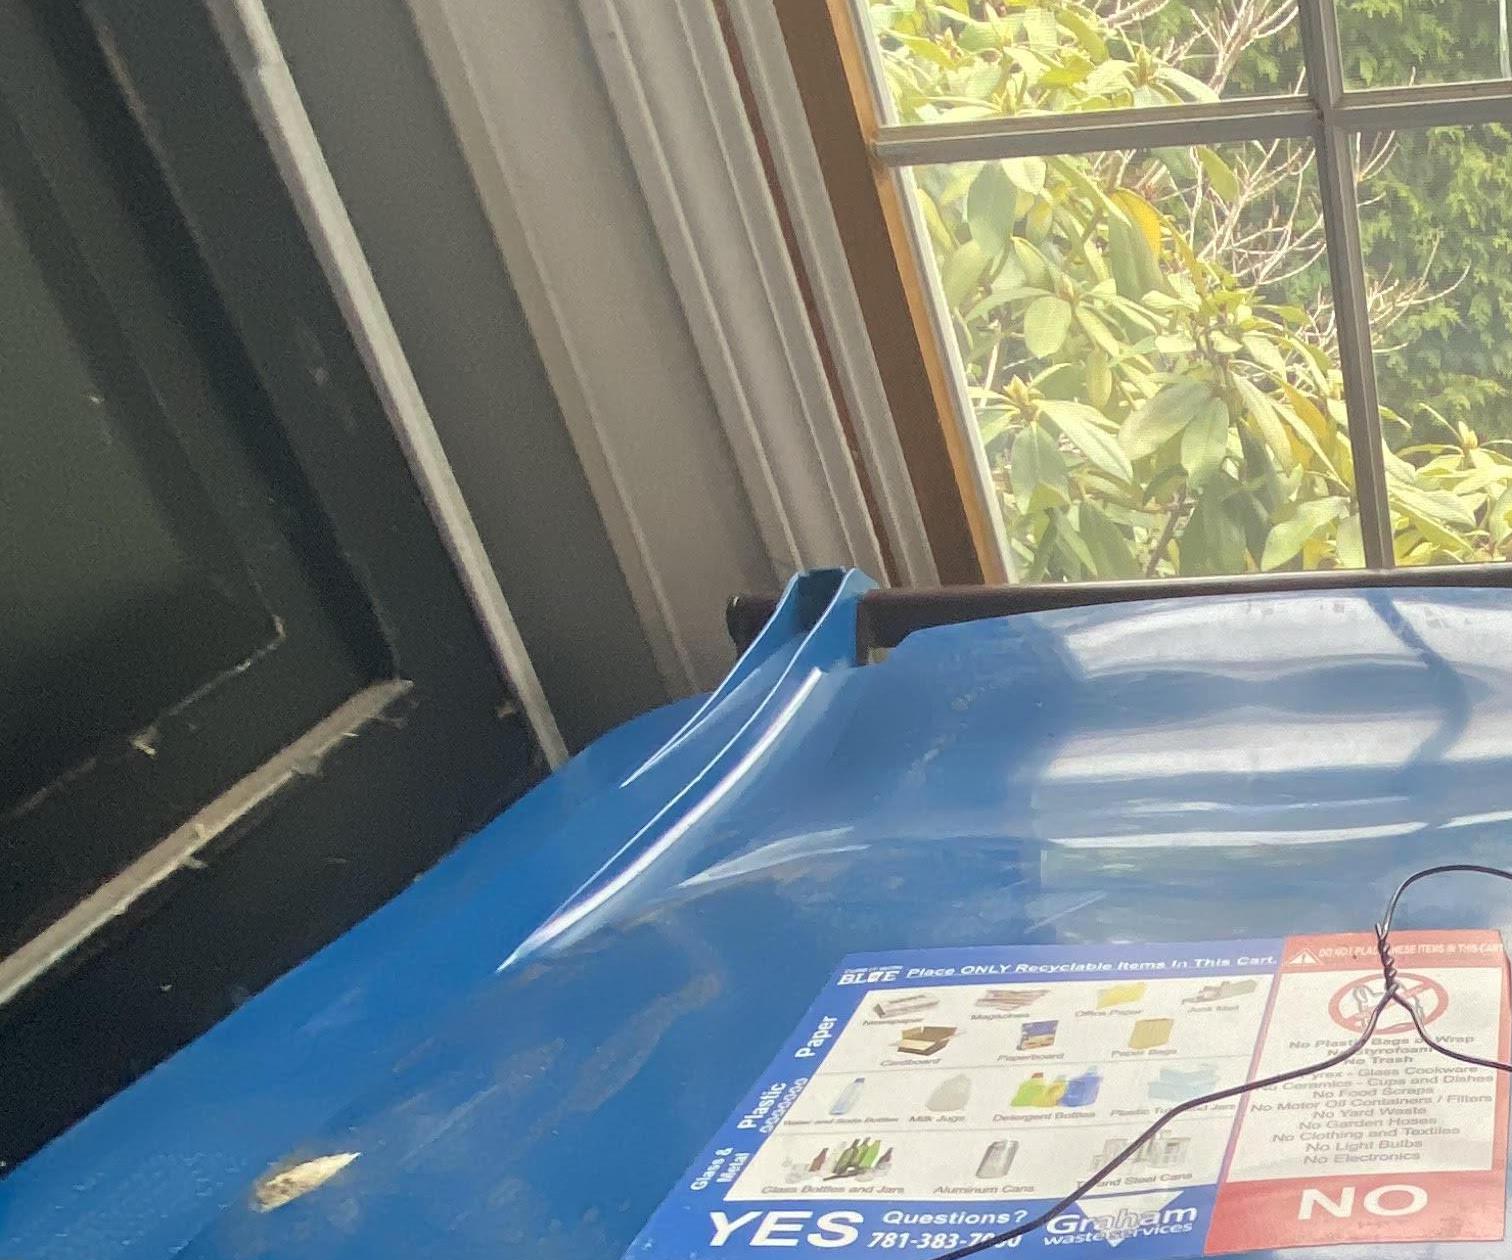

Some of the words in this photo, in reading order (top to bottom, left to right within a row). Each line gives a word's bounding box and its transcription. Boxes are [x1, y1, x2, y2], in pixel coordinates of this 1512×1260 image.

[906, 967, 955, 978] Place
[960, 964, 1011, 977] ONLY
[1014, 962, 1112, 974] Recyclable
[1117, 961, 1166, 971] Items
[1171, 960, 1187, 969] In
[1194, 958, 1230, 968] This
[794, 1015, 838, 1059] Paper
[1289, 1041, 1311, 1049] No
[1371, 1056, 1414, 1064] Trash
[1358, 1068, 1399, 1077] Glass
[1404, 1066, 1479, 1075] Cookware
[1282, 1080, 1352, 1091] Ceramics
[1367, 1078, 1406, 1088] Cups
[1410, 1076, 1438, 1085] and
[1442, 1074, 1494, 1084] Dishes
[1312, 1090, 1335, 1099] No
[1339, 1088, 1378, 1098] Food
[1382, 1086, 1434, 1097] Scraps
[736, 1081, 787, 1130] Plastic
[1250, 1103, 1273, 1113] No
[1277, 1101, 1321, 1111] Motor
[1324, 1098, 1347, 1108] Oil
[1350, 1096, 1433, 1107] Containers
[1446, 1094, 1493, 1104] Filters
[908, 1114, 933, 1123] Milk
[992, 1112, 1053, 1122] Detergent
[1054, 1110, 1096, 1120] Bottles
[1312, 1110, 1335, 1119] No
[1340, 1108, 1375, 1118] Yard
[1379, 1106, 1427, 1116] Waste
[1299, 1121, 1322, 1130] No
[1325, 1119, 1384, 1129] Garden
[1388, 1117, 1438, 1127] Hoses
[1272, 1133, 1295, 1142] No
[1299, 1130, 1364, 1141] Clothing
[1367, 1128, 1398, 1138] and
[1304, 1142, 1330, 1153] No
[1335, 1140, 1374, 1152] Light
[1378, 1138, 1424, 1150] Bulbs
[1303, 1154, 1329, 1165] No
[1333, 1152, 1421, 1164] Electronics
[690, 1158, 721, 1191] Glass
[716, 1152, 750, 1184] Metal
[1160, 1172, 1193, 1183] Cans
[761, 1185, 798, 1195] Glass
[800, 1184, 846, 1194] Bottles
[848, 1185, 874, 1194] and
[876, 1184, 905, 1195] Jars
[932, 1184, 999, 1195] Aluminum
[1002, 1183, 1035, 1194] Cans
[1298, 1184, 1428, 1221] NO
[881, 1208, 1029, 1226] Questions?
[1045, 1206, 1199, 1236] Graham
[708, 1210, 866, 1248] YES
